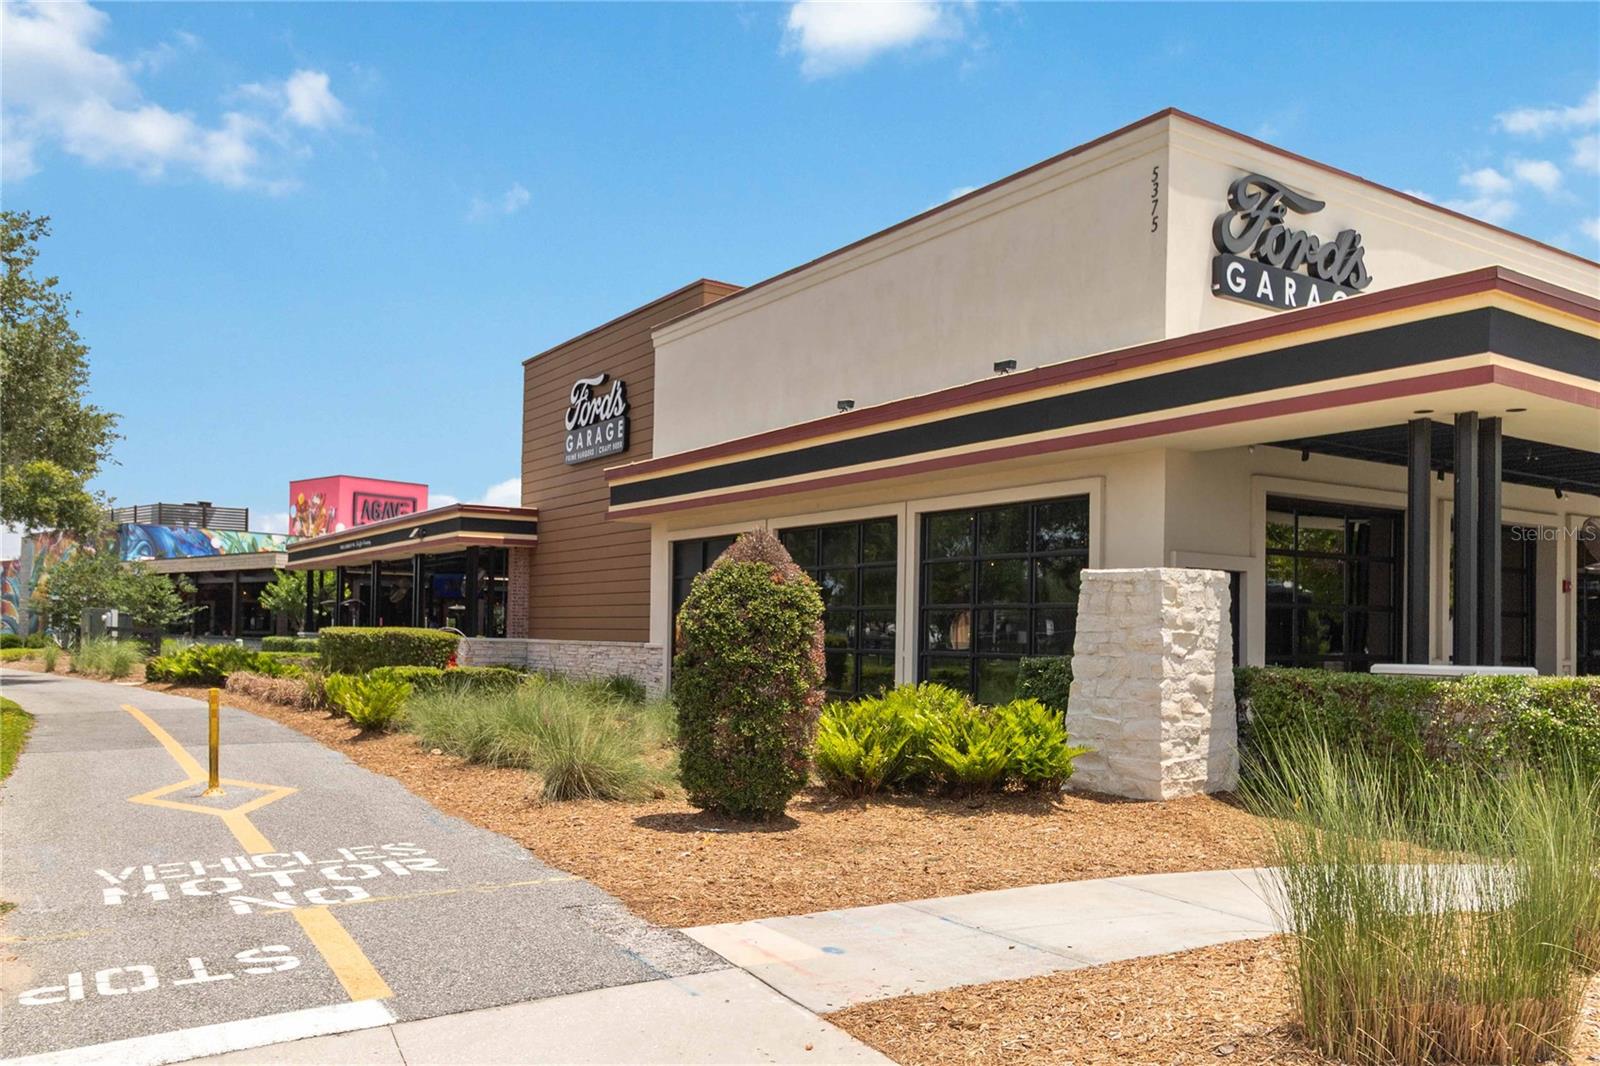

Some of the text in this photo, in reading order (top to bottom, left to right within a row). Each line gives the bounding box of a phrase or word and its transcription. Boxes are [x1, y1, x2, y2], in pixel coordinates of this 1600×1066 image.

[1150, 165, 1159, 233] 5375
[1213, 174, 1373, 290] Ford's
[565, 373, 626, 431] Ford's
[565, 419, 624, 453] GARAGE
[598, 442, 612, 454] CRAFT
[95, 842, 427, 884] VEHICLES
[101, 857, 449, 906] MOTOR
[227, 885, 371, 915] NO
[17, 944, 302, 1006] STOP
